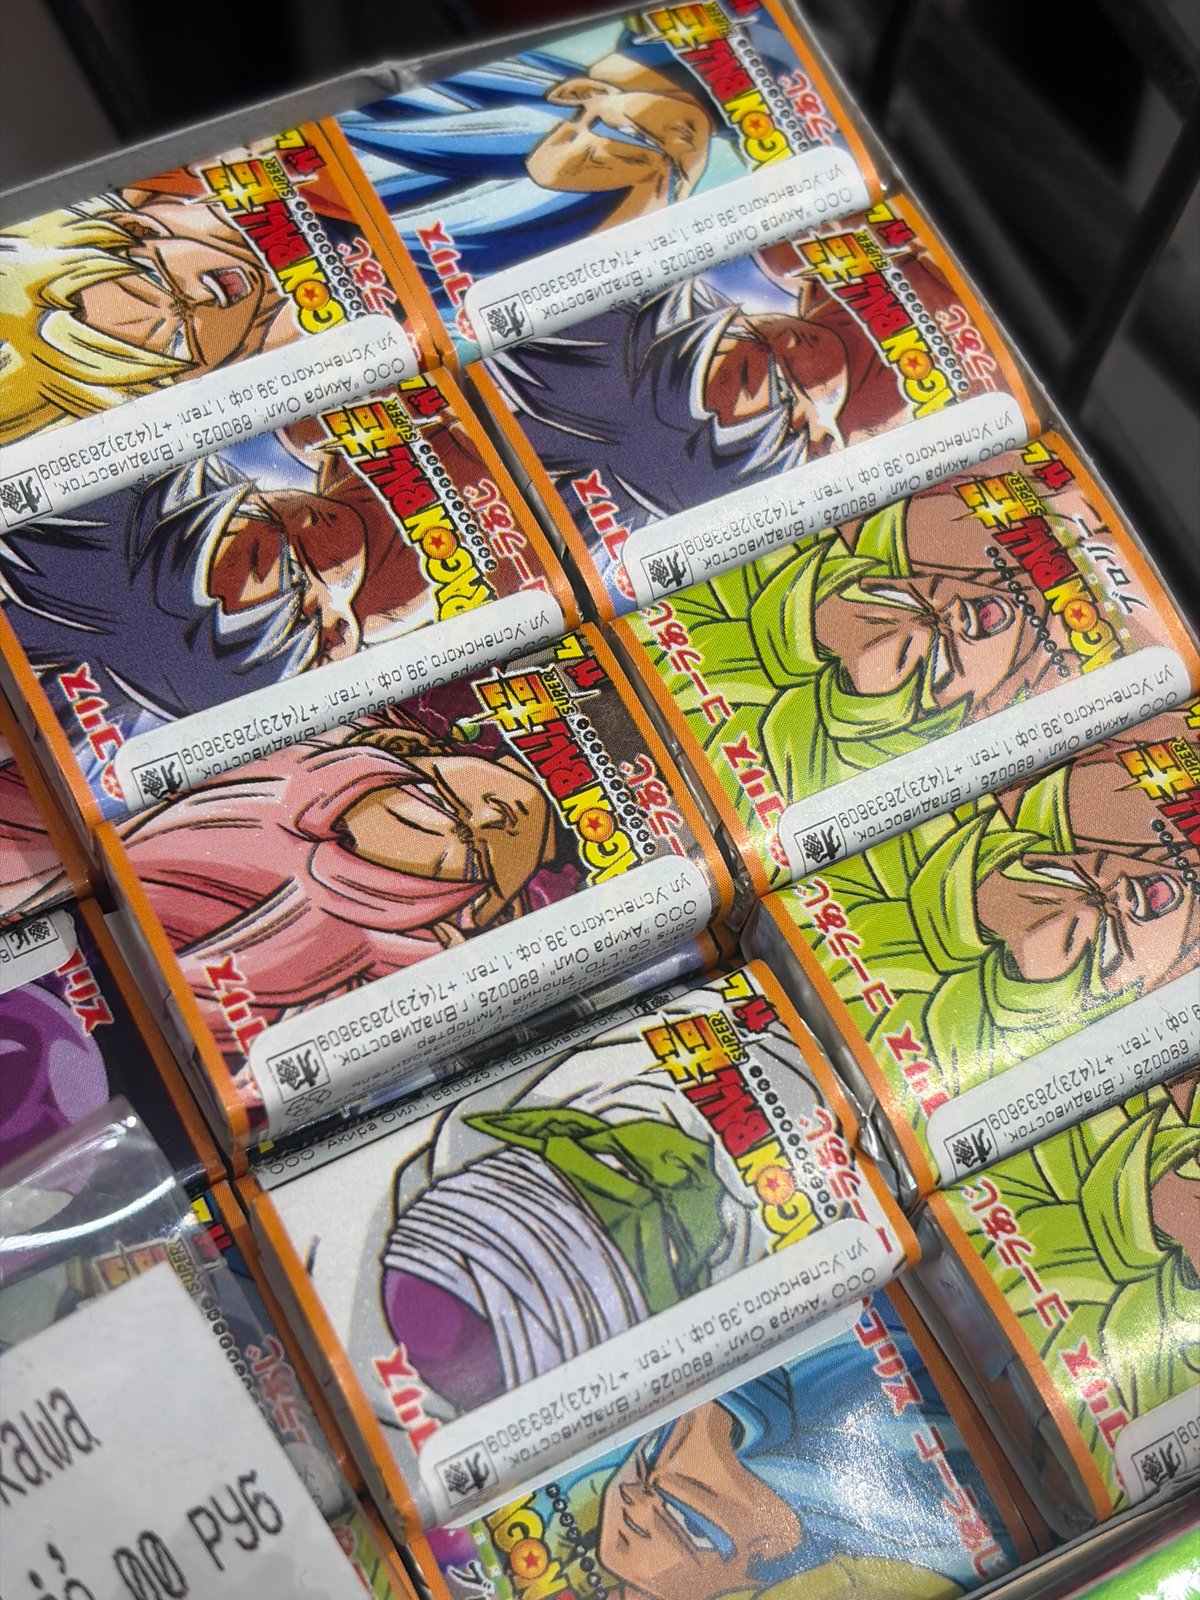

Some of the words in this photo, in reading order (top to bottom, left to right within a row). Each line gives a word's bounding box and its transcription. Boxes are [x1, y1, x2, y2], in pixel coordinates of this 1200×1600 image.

[680, 33, 754, 104] BALL
[264, 156, 294, 199] SUPER
[235, 195, 312, 271] BALL
[855, 230, 888, 270] SUPER
[833, 267, 913, 340] BALL
[361, 355, 405, 383] ООО
[37, 414, 173, 480] +7(423)2633609
[385, 398, 419, 444] SUPER
[53, 435, 184, 501] г.Владивосток,
[356, 437, 438, 519] BALL
[1004, 470, 1045, 517] SUPER
[400, 499, 496, 627] RAGON
[463, 476, 550, 599] ーラあじ
[992, 507, 1077, 592] BALL
[1067, 510, 1149, 620] ブロリー
[541, 669, 575, 717] SUPER
[631, 593, 734, 728] コーラあじ
[56, 660, 126, 761] コリス
[179, 700, 320, 765] +7(423)2633609
[1082, 708, 1133, 742] "Акира
[1136, 689, 1178, 718] ООО
[511, 713, 596, 800] BALL
[619, 750, 698, 863] ーラあじ
[837, 759, 964, 830] +7(423)2633609
[851, 780, 974, 845] г.Владивосток,
[591, 916, 649, 954] "Акира
[651, 898, 698, 929] ООО
[792, 873, 899, 1017] コーラあじ
[314, 973, 459, 1051] +7(423)2633609
[331, 995, 470, 1070] г.Владивосток,
[708, 1010, 749, 1066] SUPER
[685, 1063, 775, 1155] BALL
[986, 1048, 1116, 1131] +7(423)2633609
[1003, 1071, 1127, 1145] г.Владивосток,
[796, 1104, 884, 1238] ーラあじ
[829, 1265, 878, 1301] ООО
[958, 1173, 1071, 1330] コーラあじ
[847, 1307, 925, 1416] コリス
